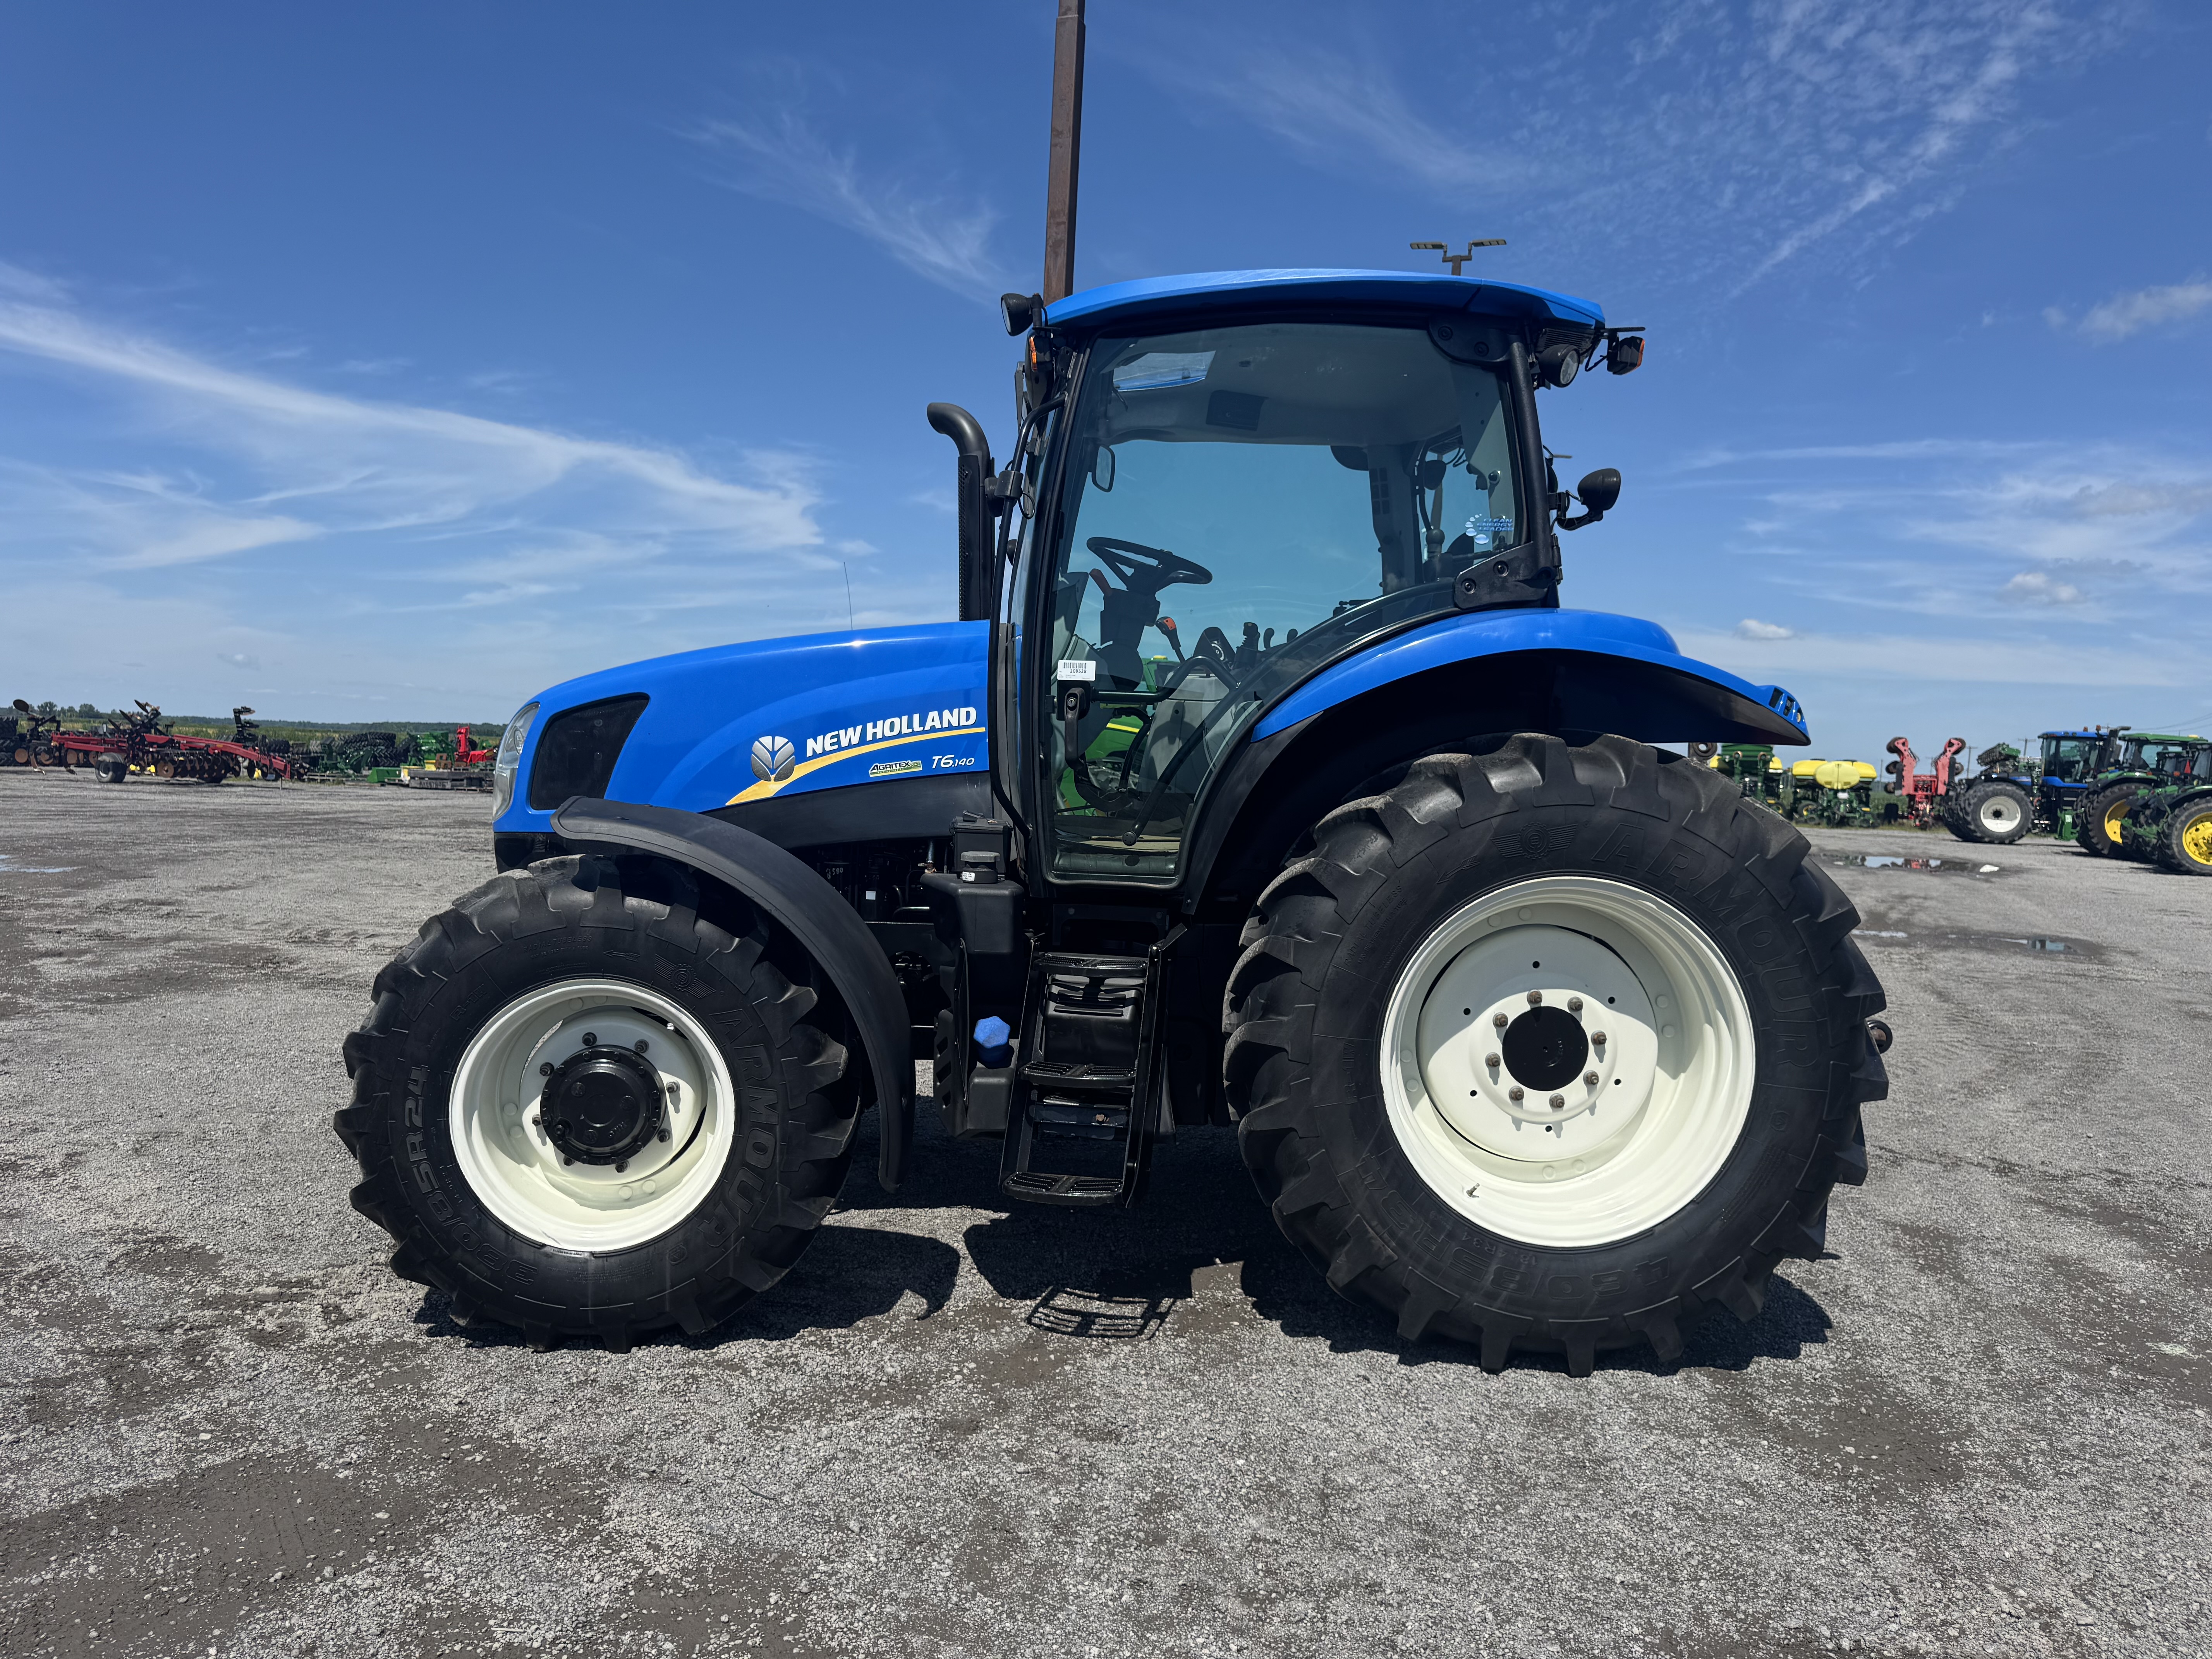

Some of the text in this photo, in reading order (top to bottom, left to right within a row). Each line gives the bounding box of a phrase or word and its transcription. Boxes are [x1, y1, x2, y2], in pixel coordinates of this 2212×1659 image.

[807, 707, 977, 757] NEW HOLLAND
[870, 761, 910, 772] AGRITEX
[932, 754, 975, 769] T6.140
[1591, 823, 1819, 1068] ARMOUR
[697, 1008, 780, 1248] ARMOUR
